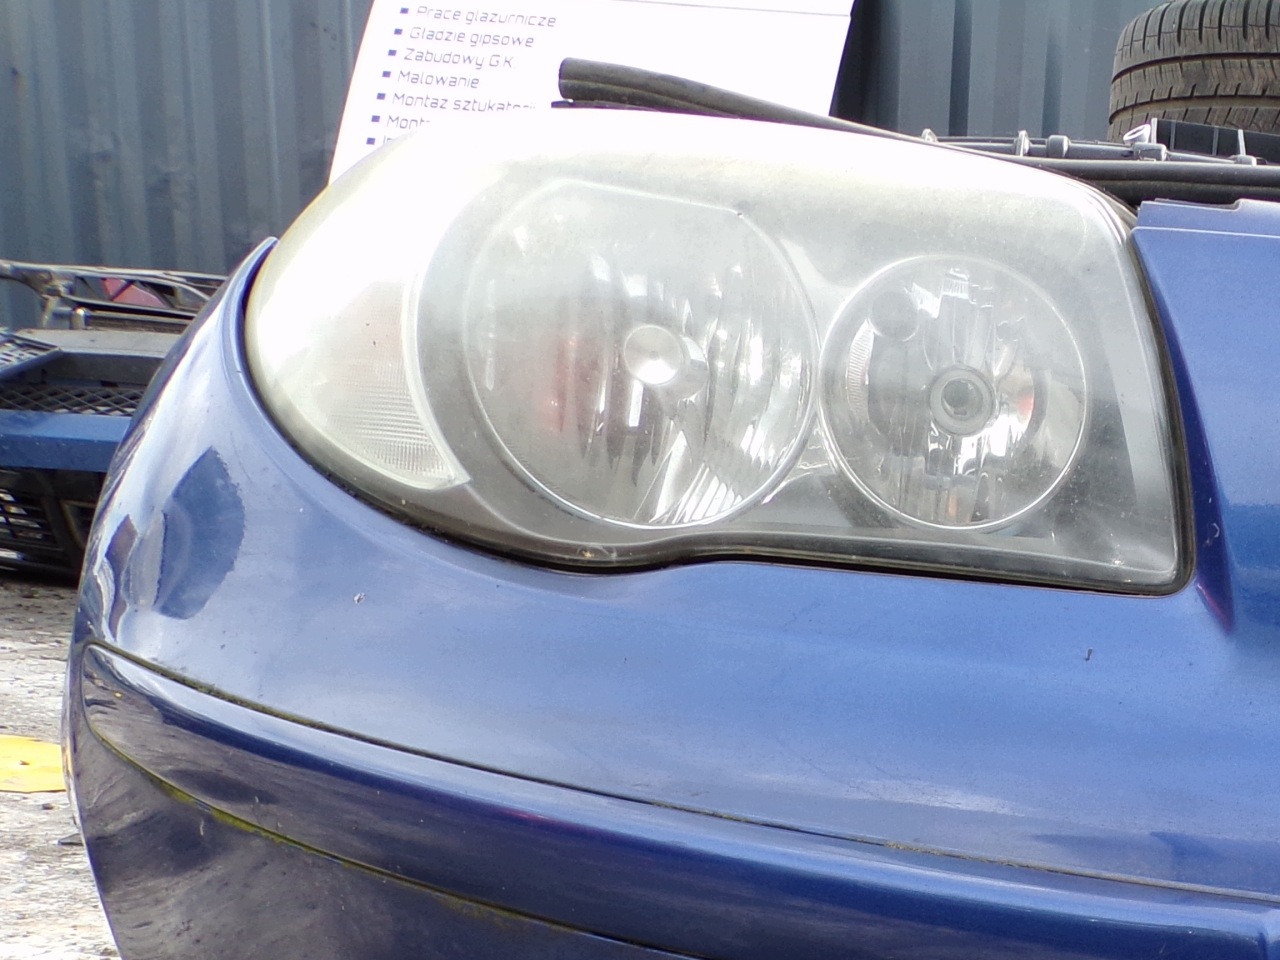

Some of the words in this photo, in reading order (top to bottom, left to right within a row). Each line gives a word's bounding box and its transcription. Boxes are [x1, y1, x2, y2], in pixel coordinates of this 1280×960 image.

[416, 5, 461, 21] Prace
[465, 9, 556, 28] glazurnicze
[470, 33, 534, 48] gipsowe
[403, 47, 485, 70] Zabudowy
[397, 70, 479, 89] Malowanie
